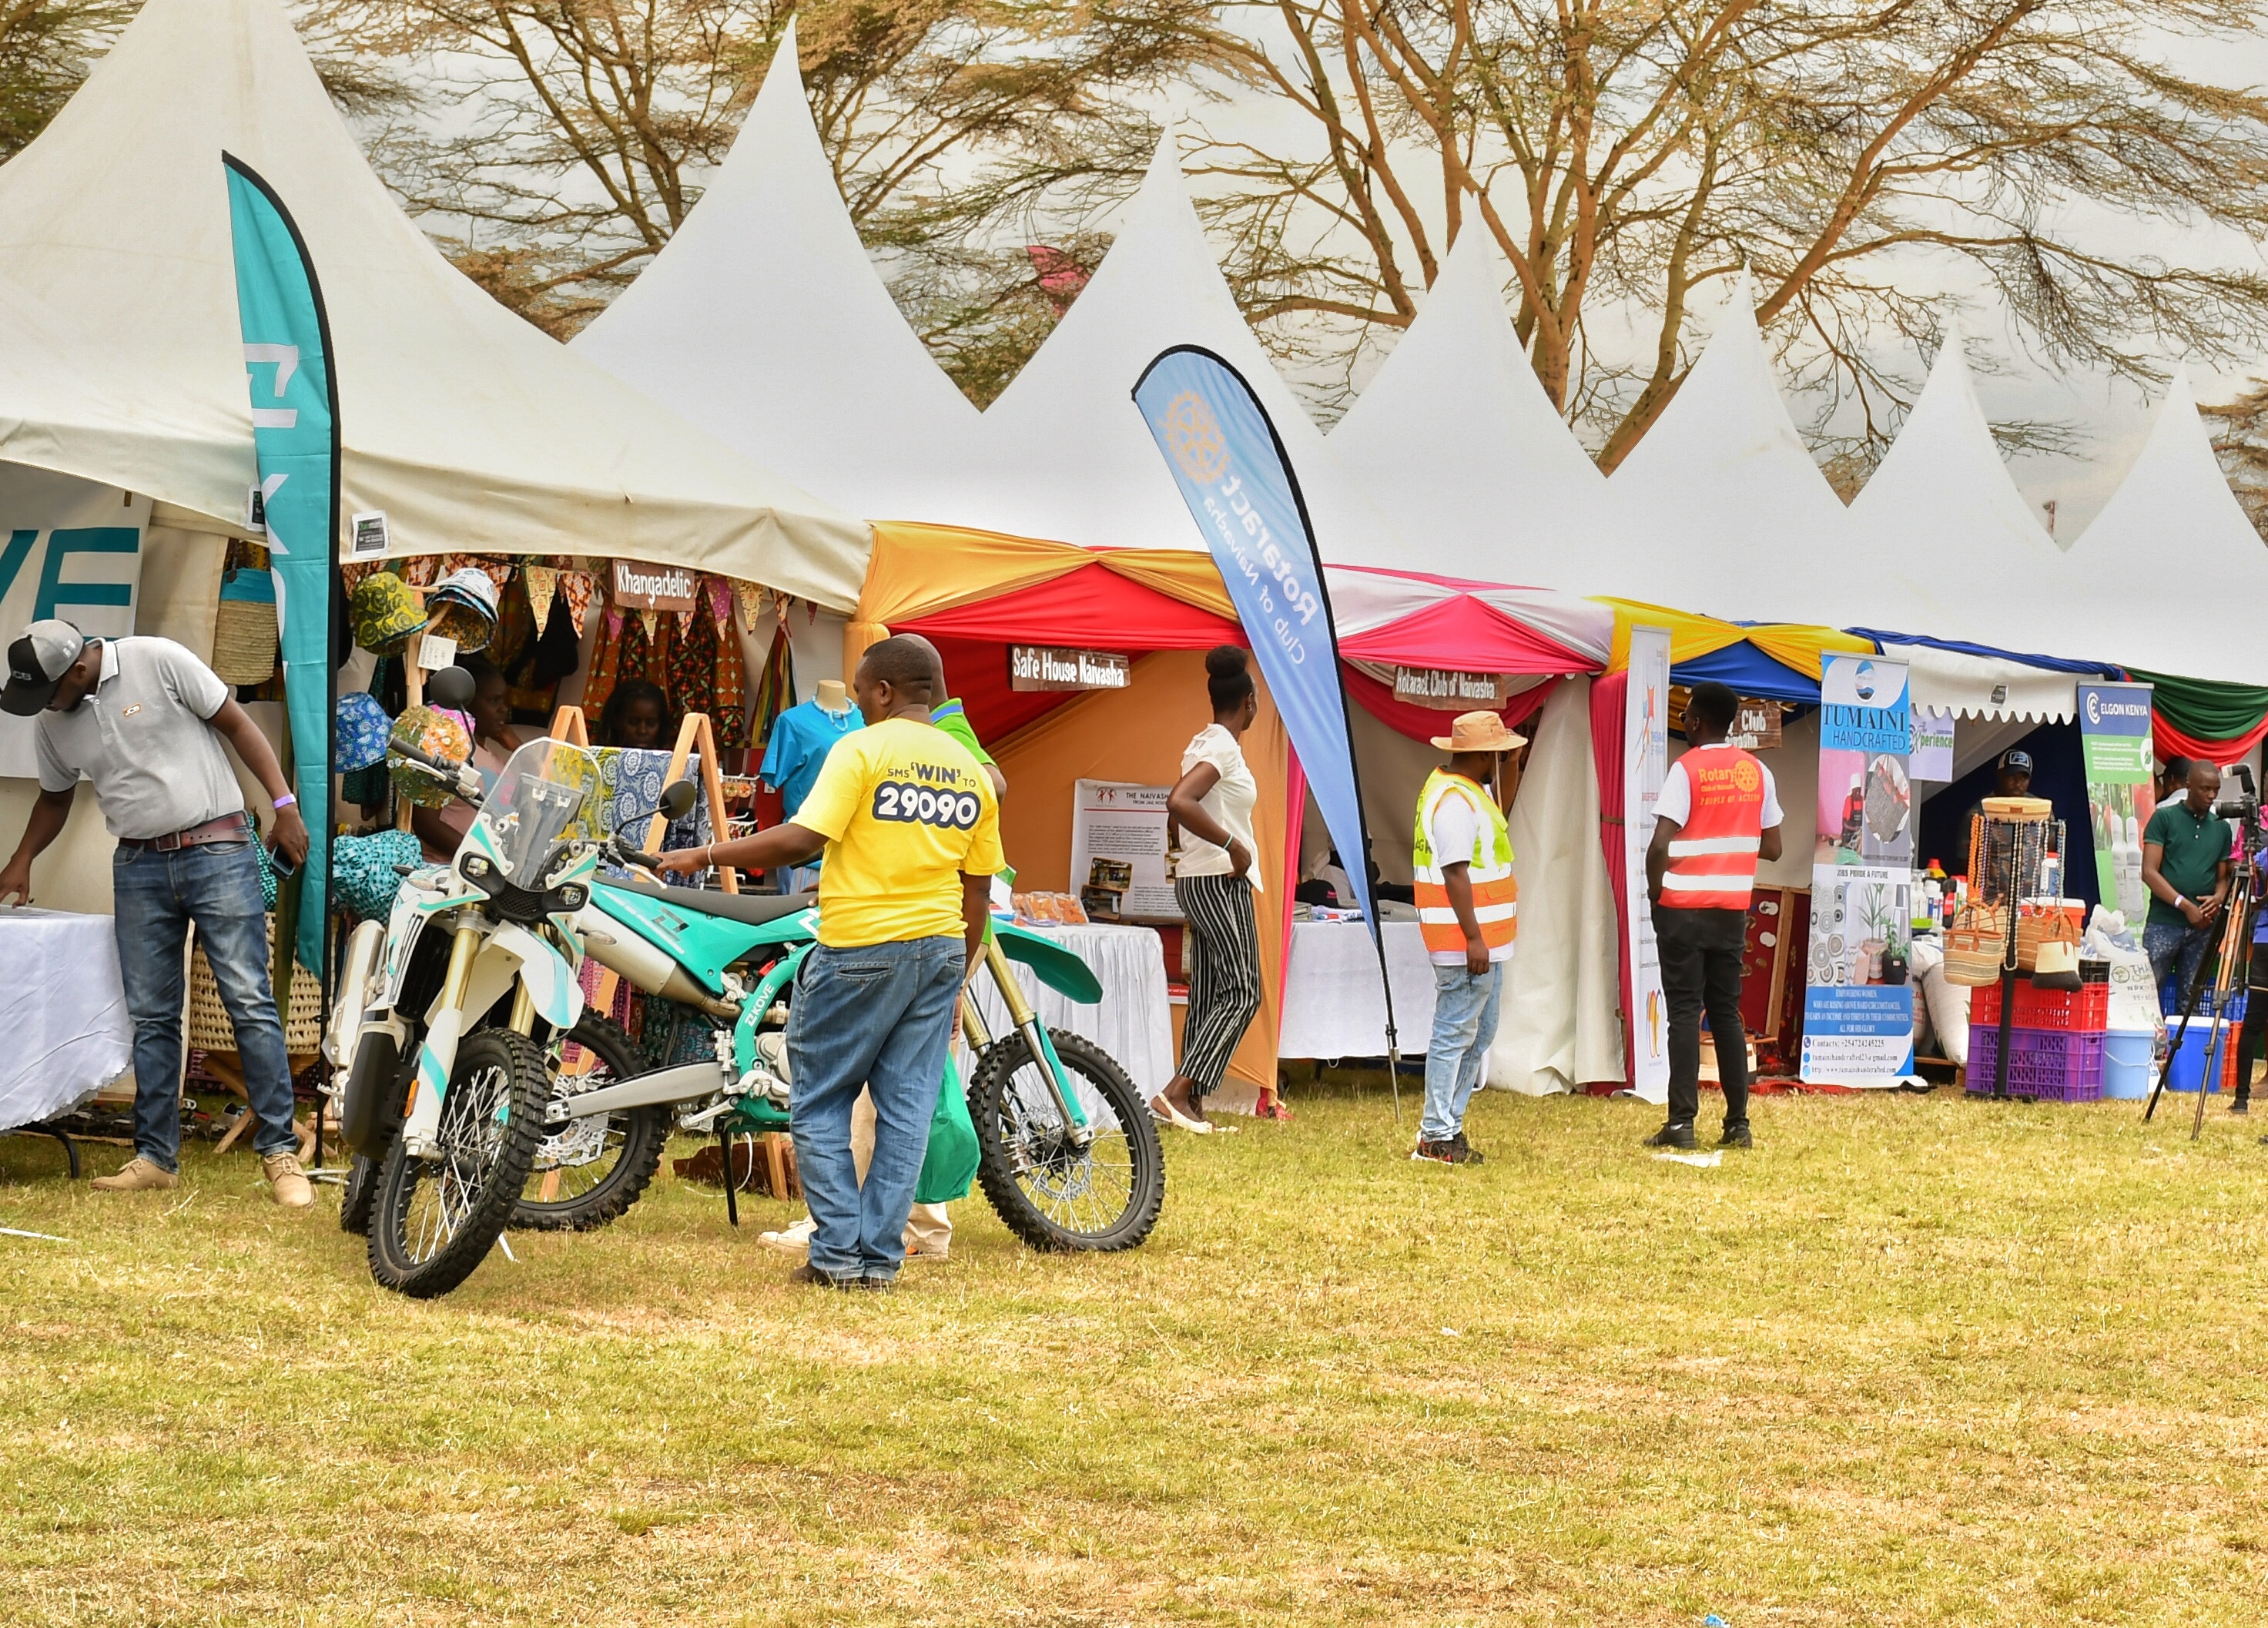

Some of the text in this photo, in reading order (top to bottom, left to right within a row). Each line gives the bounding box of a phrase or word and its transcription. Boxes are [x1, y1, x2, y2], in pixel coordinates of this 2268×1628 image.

[617, 564, 692, 605] Khangadelic
[1013, 647, 1124, 687] Safe House Naivasha
[1396, 666, 1496, 699] Rotaract Club of Naivasha
[1741, 709, 1766, 732] Club
[1823, 705, 1905, 732] TUMAINI
[2100, 703, 2148, 716] ELGON KENYA
[1725, 732, 1758, 749] aivasha
[1833, 729, 1905, 750] HANDCRAFTED
[887, 762, 977, 788] SMS 'WIN' TO
[1699, 768, 1735, 782] Rotary
[878, 786, 977, 825] 29090
[1700, 796, 1725, 806] PEOPLE
[751, 983, 775, 1017] KOVE
